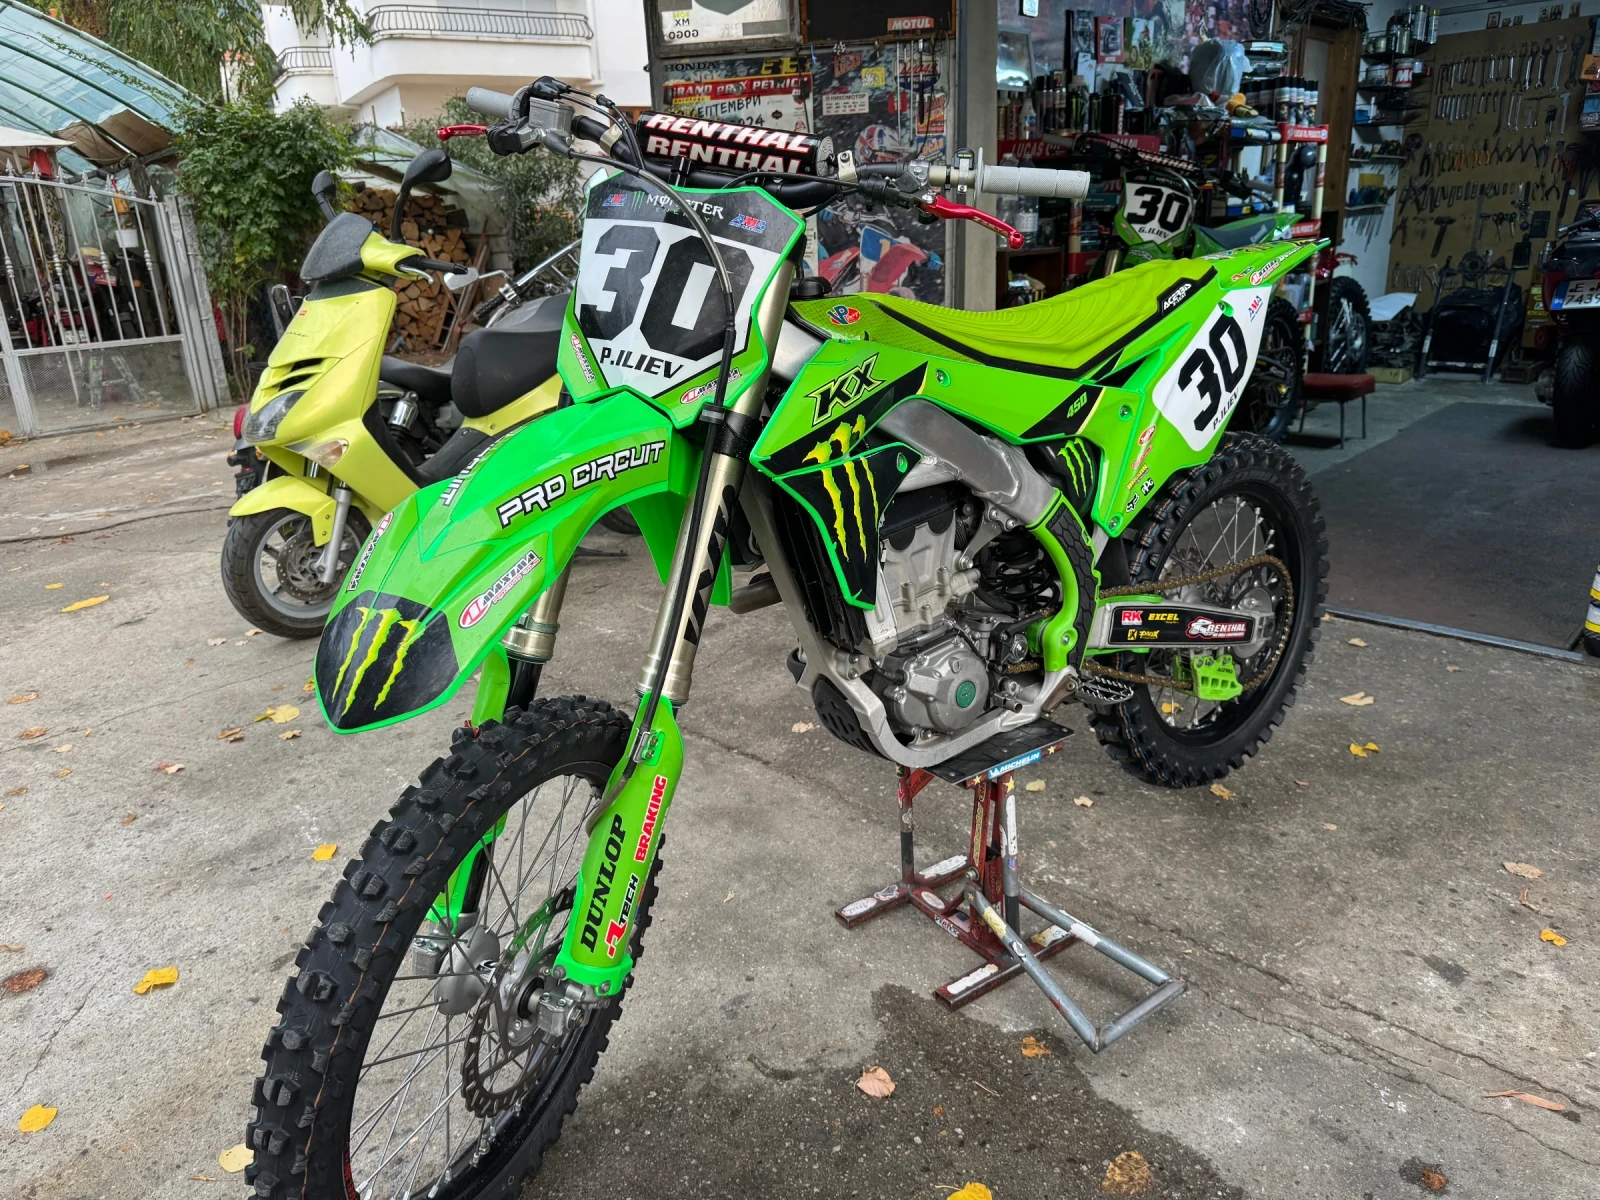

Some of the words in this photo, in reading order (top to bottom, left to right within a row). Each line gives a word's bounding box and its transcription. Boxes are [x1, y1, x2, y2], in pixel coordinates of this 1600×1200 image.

[892, 19, 931, 29] MOTUL
[664, 62, 717, 72] HONDA
[690, 71, 723, 81] NGK
[672, 83, 713, 97] RAND
[717, 80, 748, 96] PRX
[645, 113, 812, 154] RENTHAL
[646, 135, 803, 174] RENTHAL
[1012, 142, 1044, 159] LUCAS
[602, 193, 628, 204] AMA
[1126, 186, 1190, 233] 30
[730, 213, 767, 229] AMA
[1138, 226, 1169, 239] G.ILIEV
[580, 224, 755, 361] 30
[826, 304, 848, 325] VP
[1248, 295, 1262, 318] AMA
[600, 346, 684, 379] P.ILIEV
[1178, 313, 1248, 432] 30
[805, 353, 886, 427] KX
[1067, 392, 1087, 418] 450
[1213, 387, 1239, 430] P.ILIEV
[497, 474, 566, 529] PRO
[571, 441, 666, 490] CIRCUIT
[482, 551, 536, 603] MAXIMA
[1122, 611, 1143, 621] RK
[1148, 613, 1180, 621] EXCEL
[1208, 624, 1247, 632] RENTHAL
[1000, 752, 1040, 772] MICHELIN
[634, 775, 667, 863] BRAKING
[580, 813, 627, 954] DUNLOP
[935, 913, 960, 938] VERTEX
